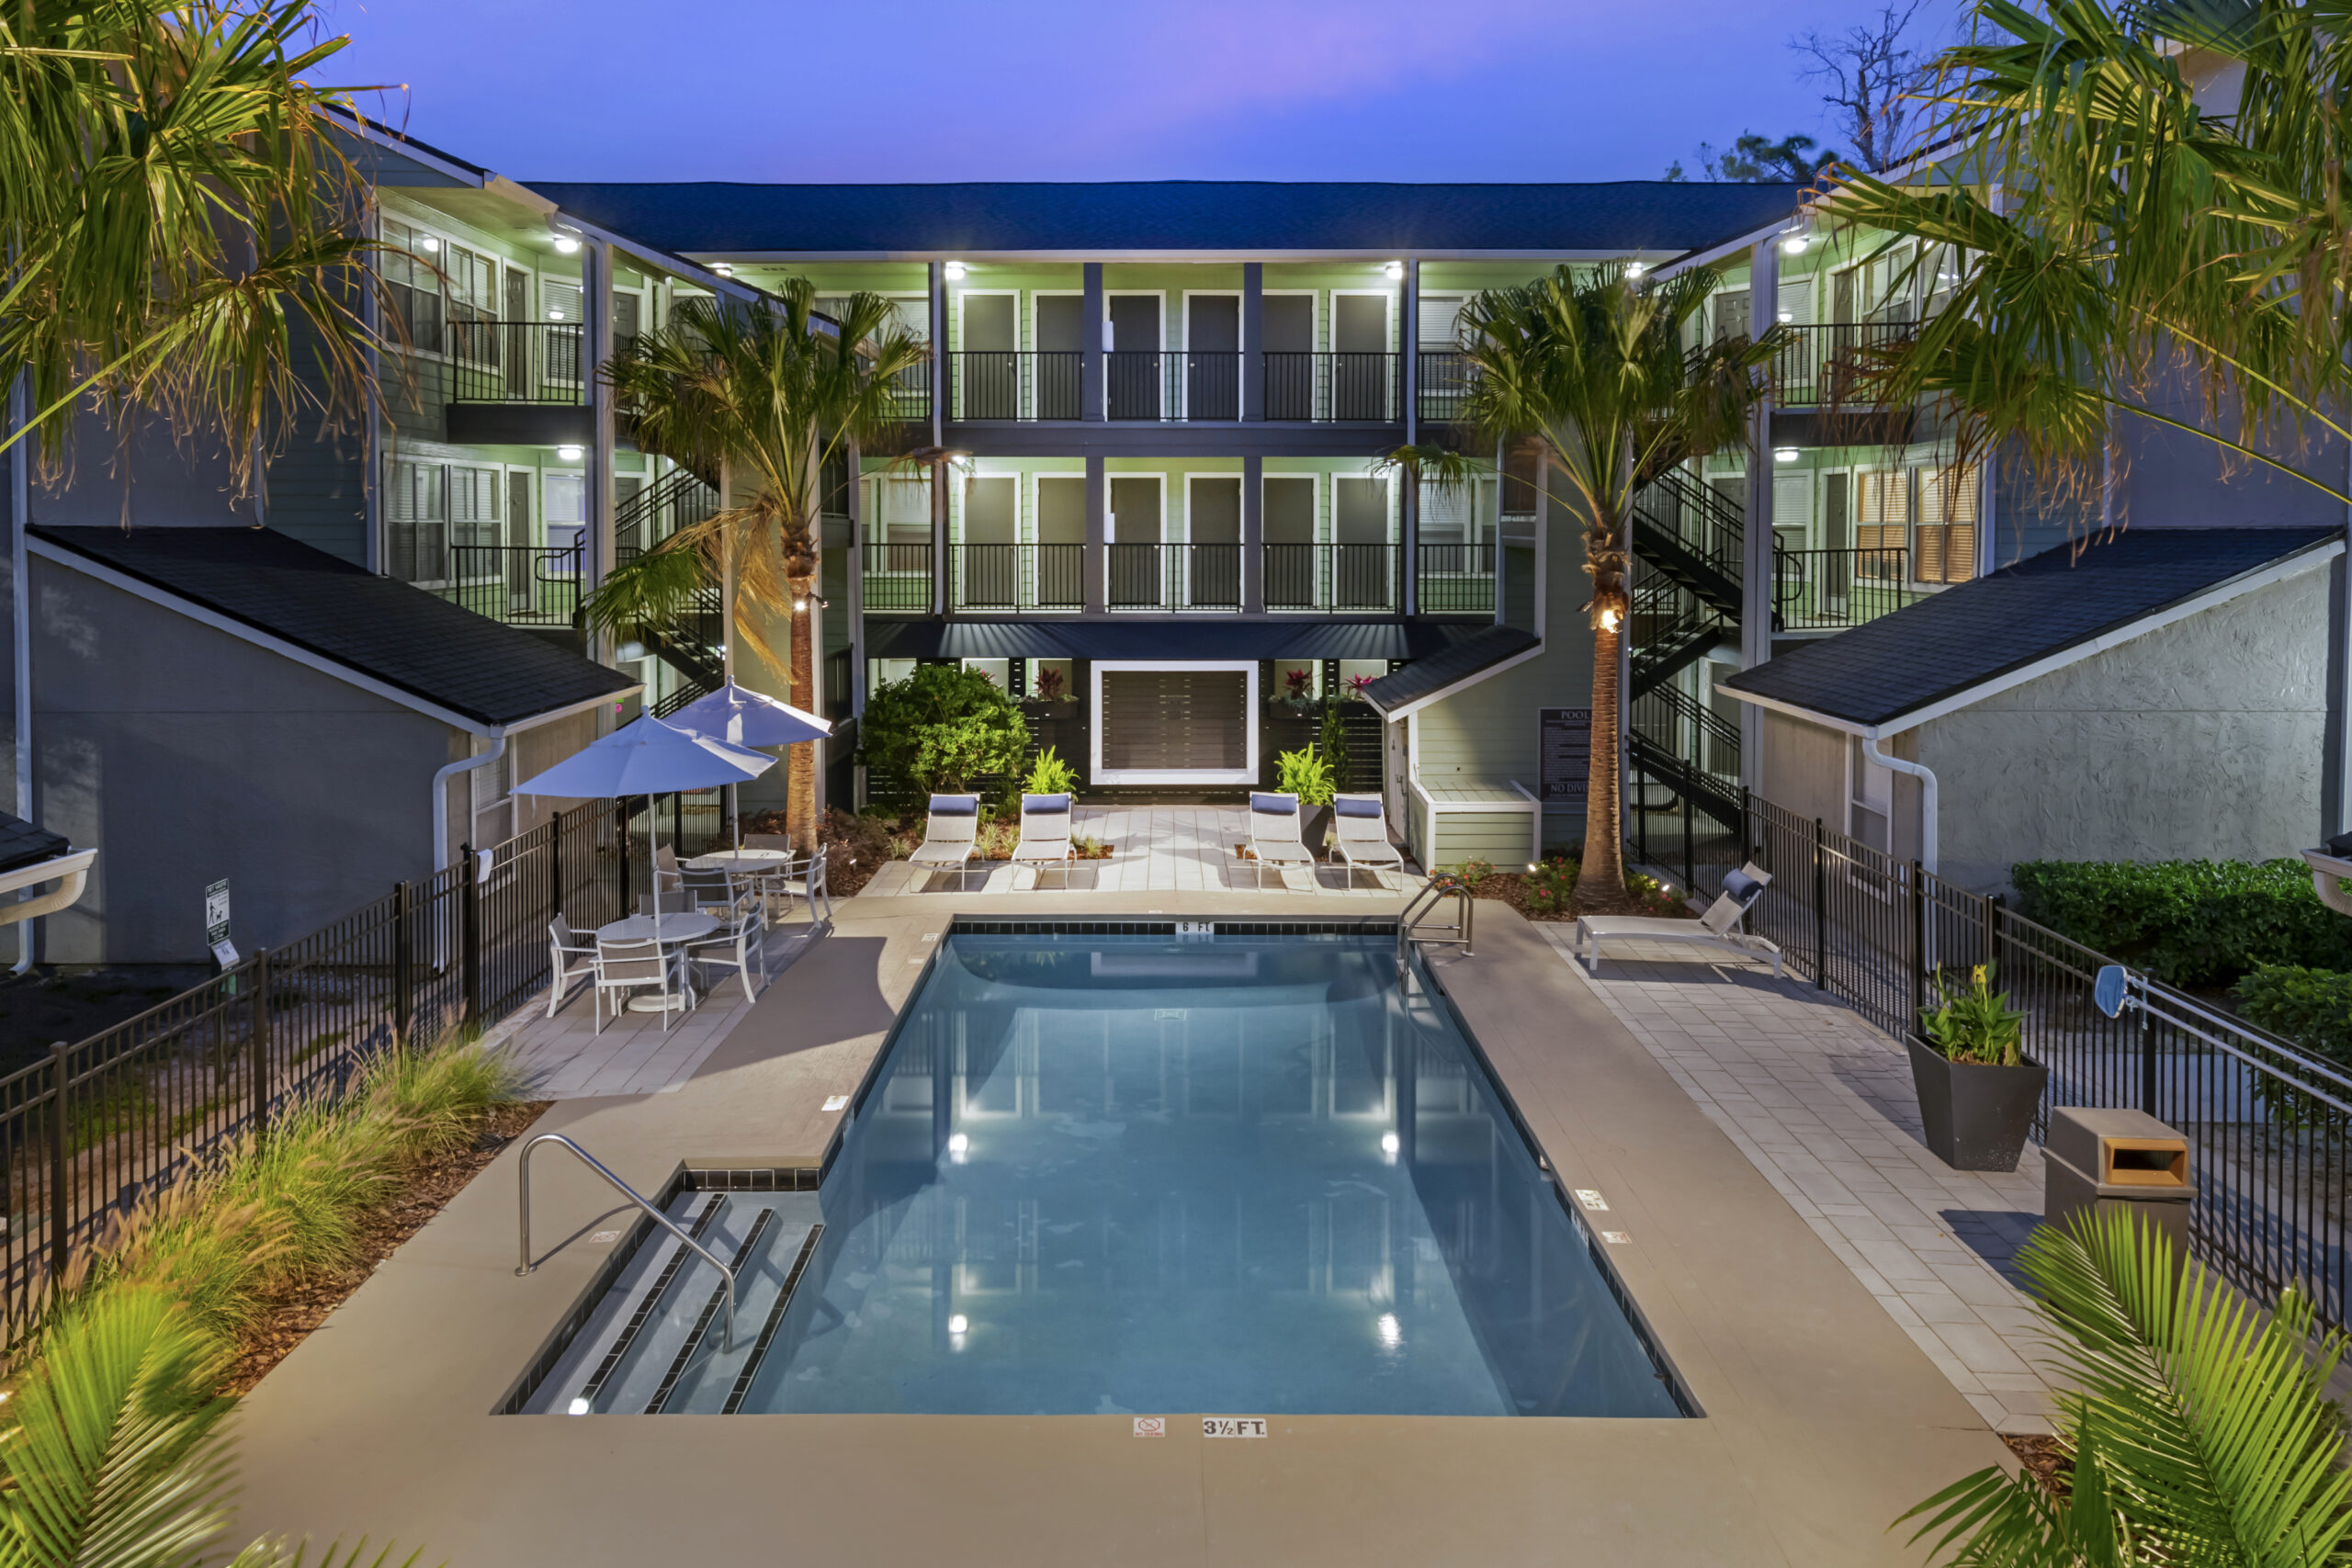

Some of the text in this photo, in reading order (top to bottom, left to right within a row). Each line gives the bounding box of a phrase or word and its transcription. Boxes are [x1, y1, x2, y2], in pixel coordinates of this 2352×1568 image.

[1561, 711, 1589, 719] POOL
[1551, 784, 1565, 793] NO
[1183, 921, 1189, 931] 6
[1237, 1420, 1265, 1435] FT.
